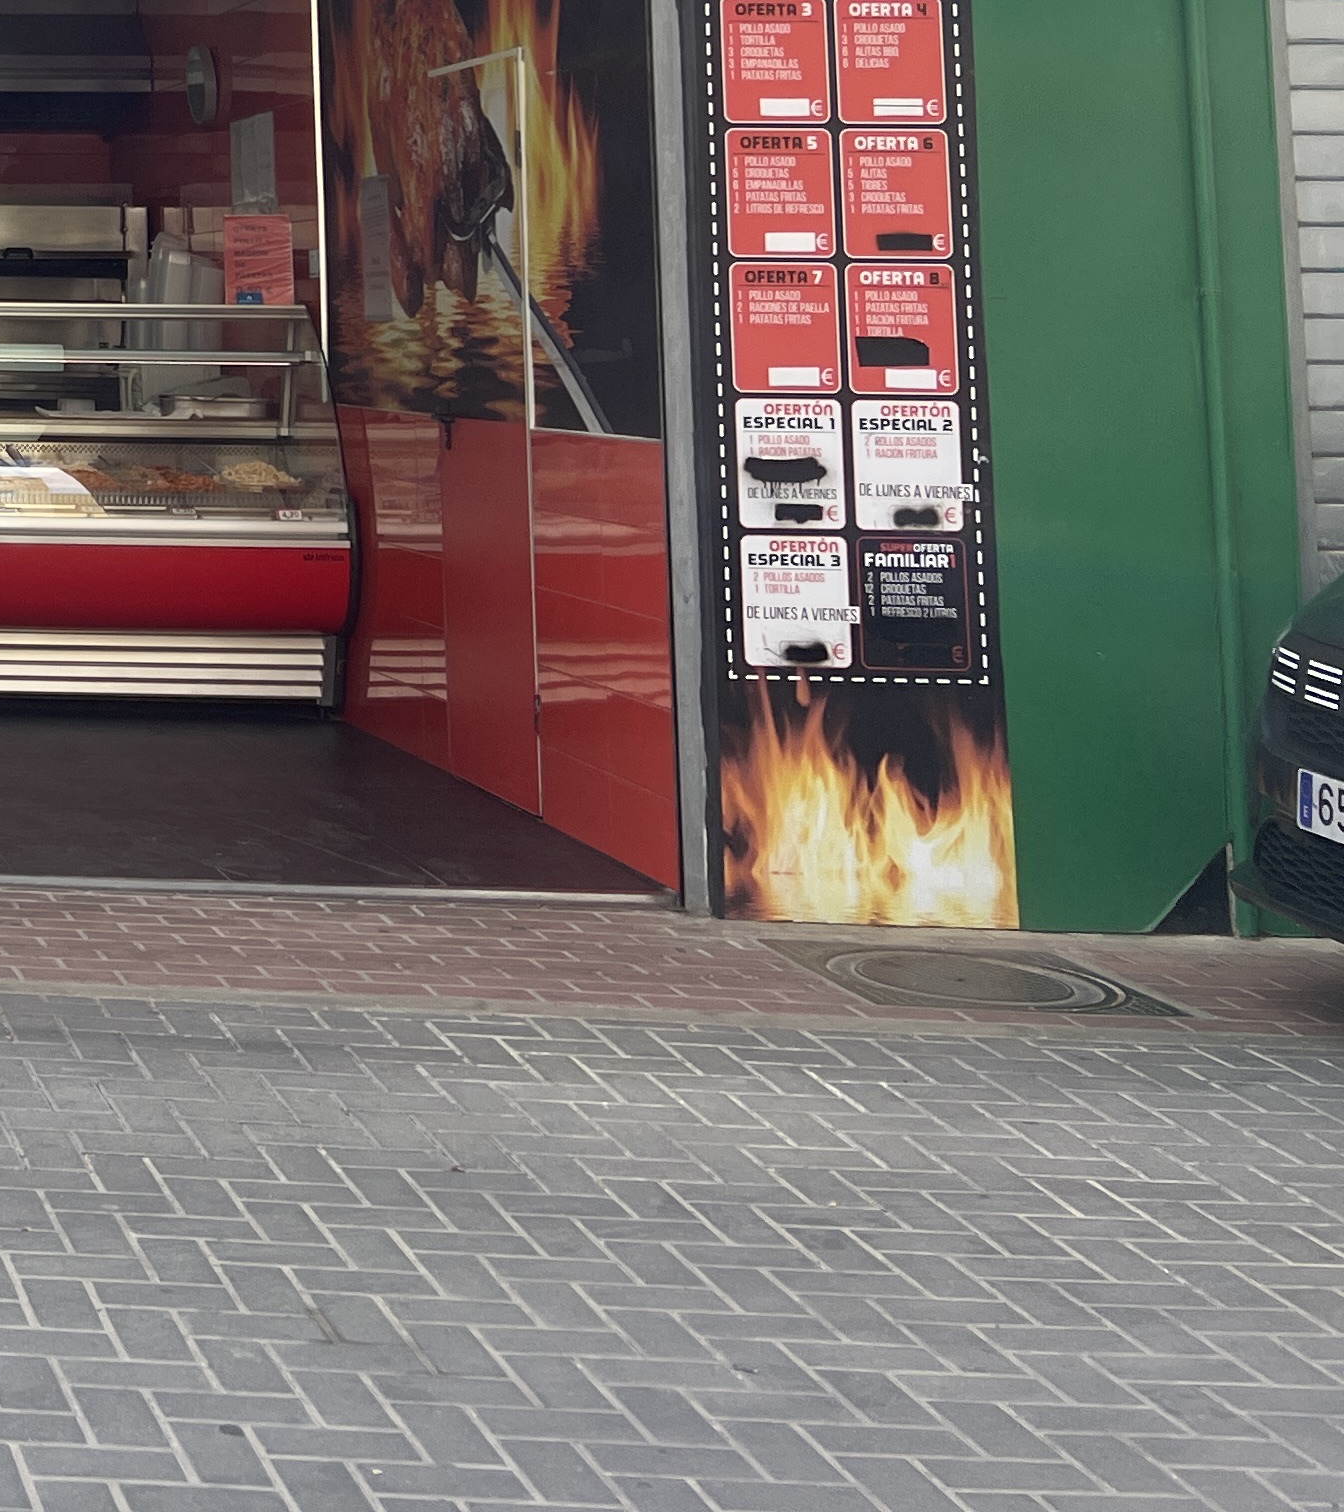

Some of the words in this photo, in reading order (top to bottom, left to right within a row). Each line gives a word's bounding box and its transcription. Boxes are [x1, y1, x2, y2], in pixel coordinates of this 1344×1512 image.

[735, 3, 797, 17] OFERTA
[801, 3, 812, 17] 3
[848, 3, 912, 17] OFERTA
[917, 3, 927, 17] 4
[740, 136, 803, 150] OFERTA
[807, 136, 818, 150] 5
[854, 137, 918, 151] OFERTA
[923, 137, 933, 150] 6
[744, 270, 808, 284] OFERTA
[812, 270, 823, 284] 7
[859, 271, 924, 285] OFERTA
[930, 272, 940, 285] 8
[764, 400, 833, 416] OFERTÓN
[880, 402, 951, 417] OFERTÓN
[743, 416, 823, 430] ESPECIAL
[829, 416, 835, 430] 1
[859, 418, 938, 432] ESPECIAL
[942, 418, 953, 432] 2
[747, 487, 760, 499] DE
[761, 487, 789, 500] LUNES
[791, 487, 800, 499] A
[801, 488, 837, 500] VIERNES
[859, 483, 873, 497] DE
[875, 484, 911, 498] LUNES
[913, 485, 922, 498] A
[923, 486, 971, 501] VIERNES
[769, 538, 839, 553] OFERTÓN
[748, 554, 825, 567] ESPECIAL
[830, 554, 841, 567] 3
[747, 606, 760, 619] DE
[763, 606, 798, 621] LUNES
[801, 607, 809, 620] A
[812, 608, 858, 622] VIERNES
